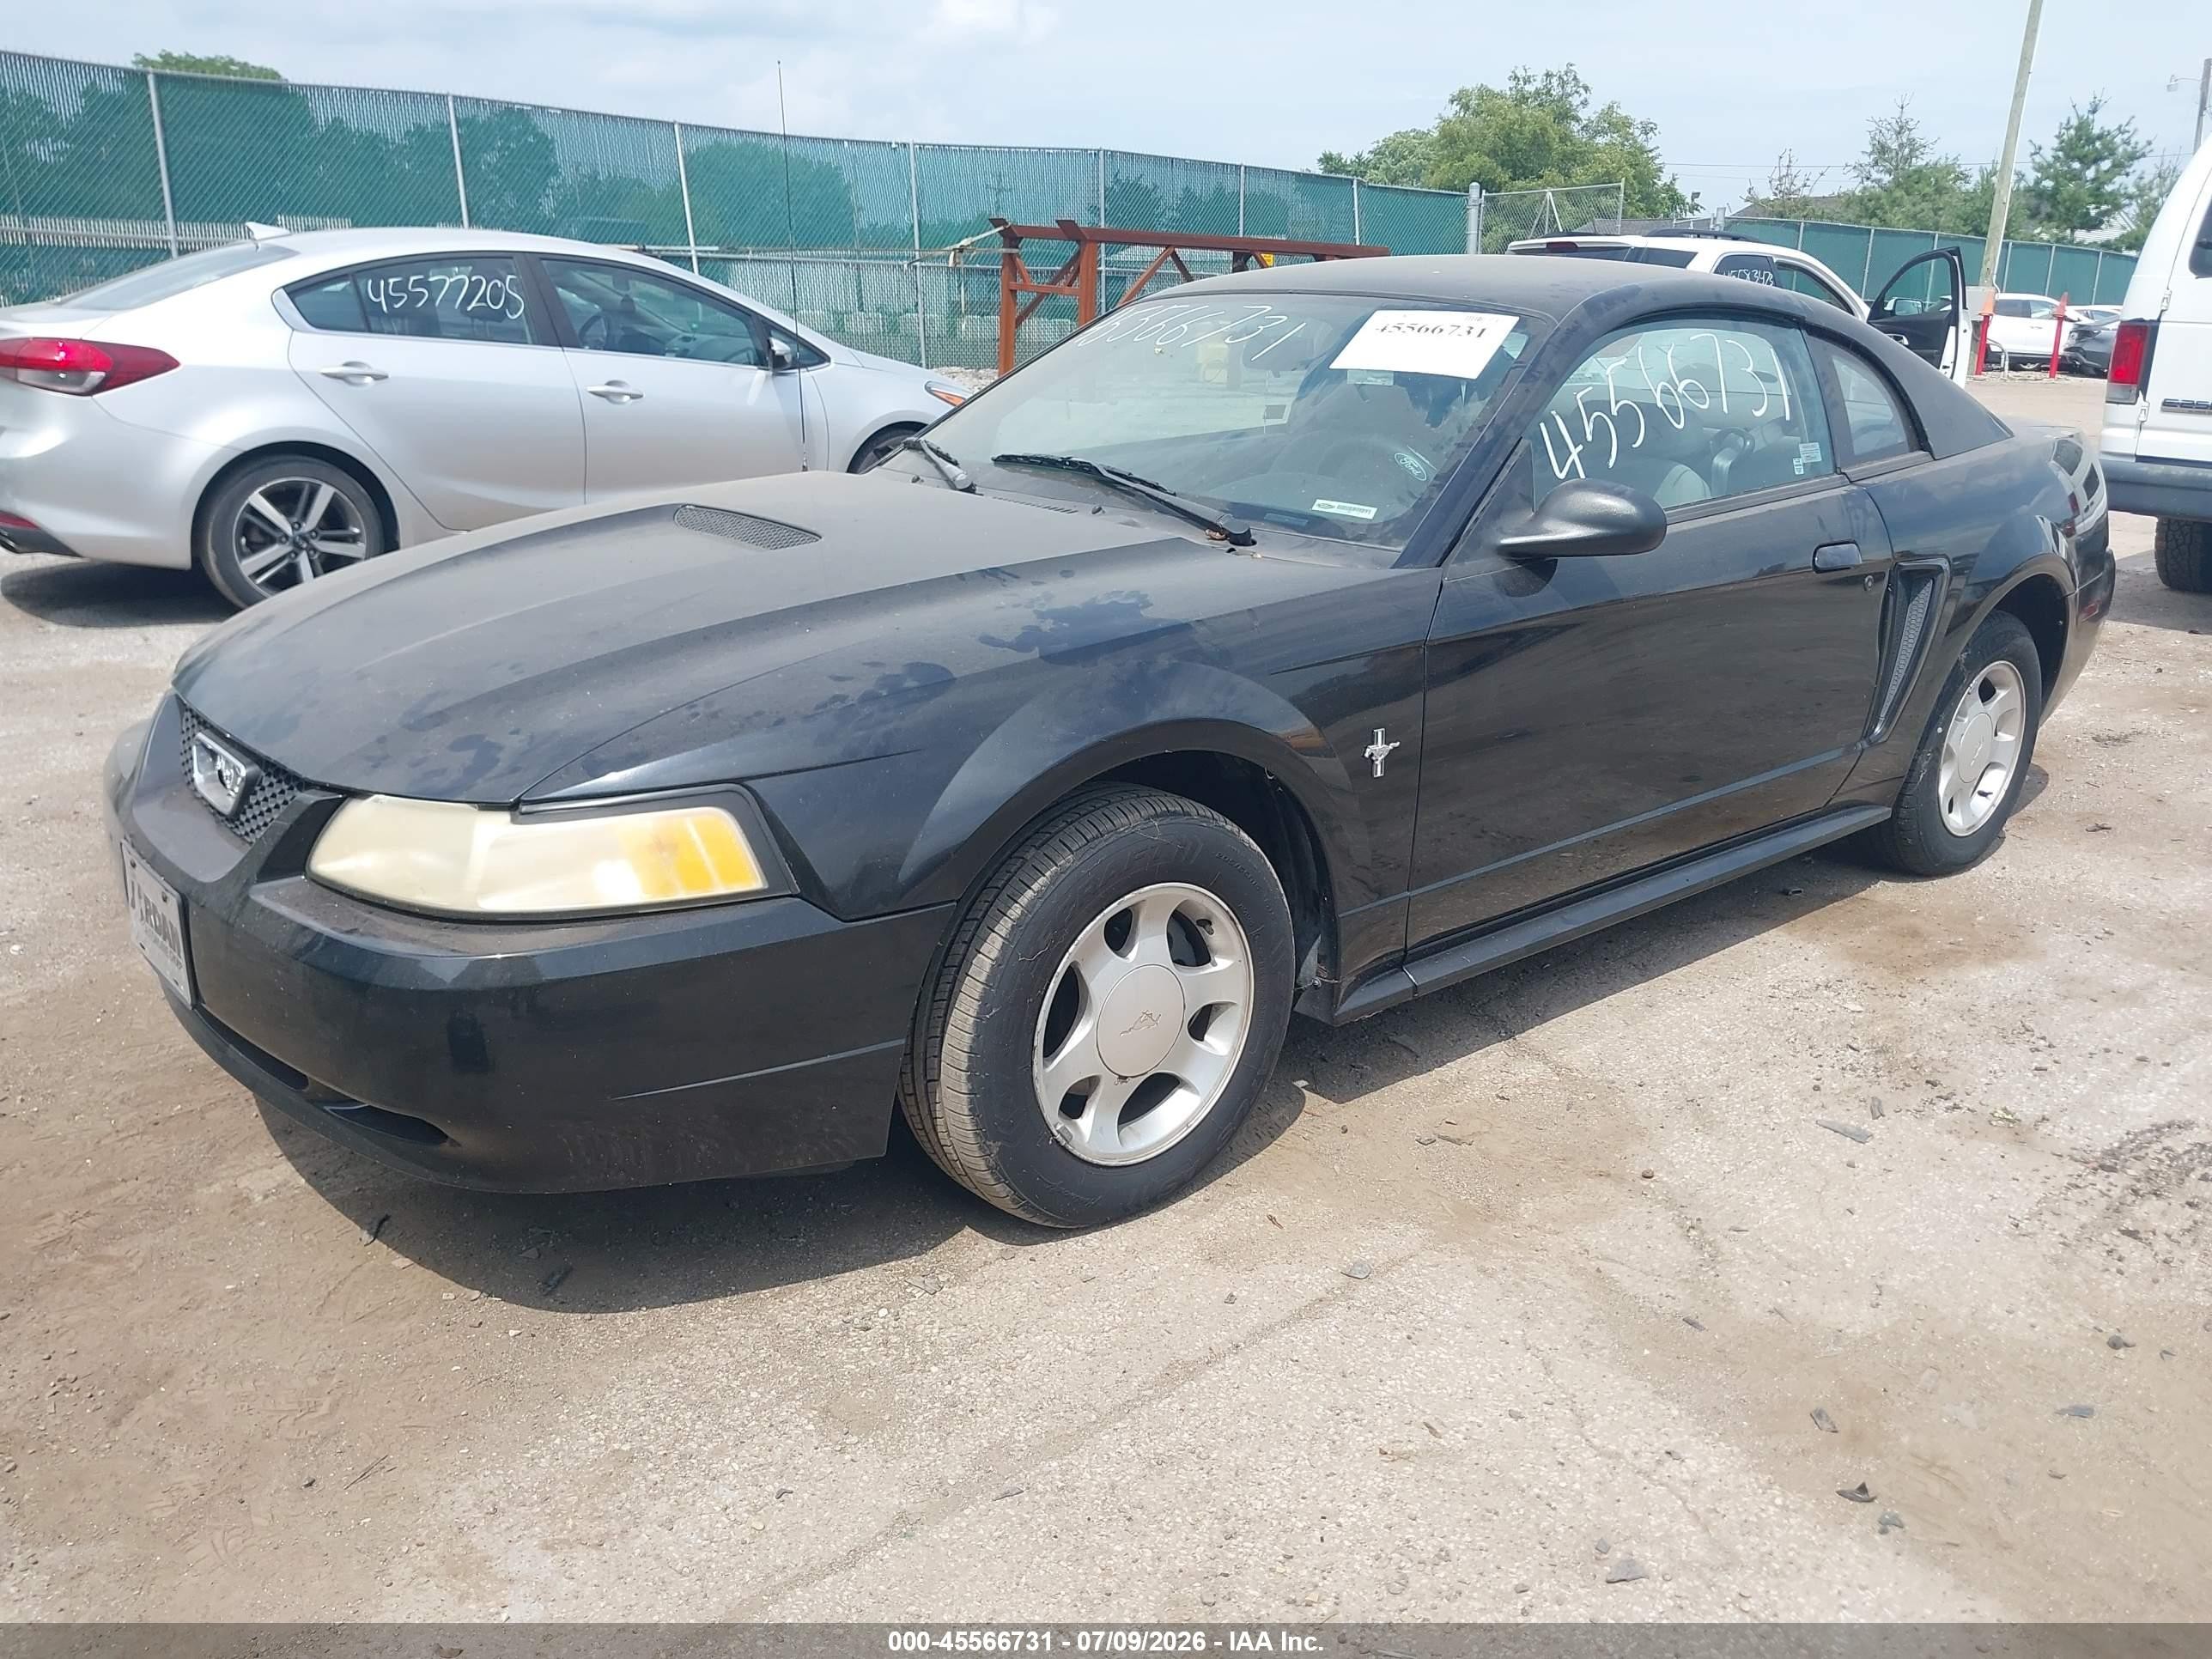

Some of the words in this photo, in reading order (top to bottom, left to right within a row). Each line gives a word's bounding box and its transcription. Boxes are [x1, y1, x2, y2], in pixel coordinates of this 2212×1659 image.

[368, 274, 525, 319] 45577205
[1375, 321, 1487, 338] 45566731
[1540, 333, 1790, 480] 45566731
[2162, 398, 2212, 410] E25
